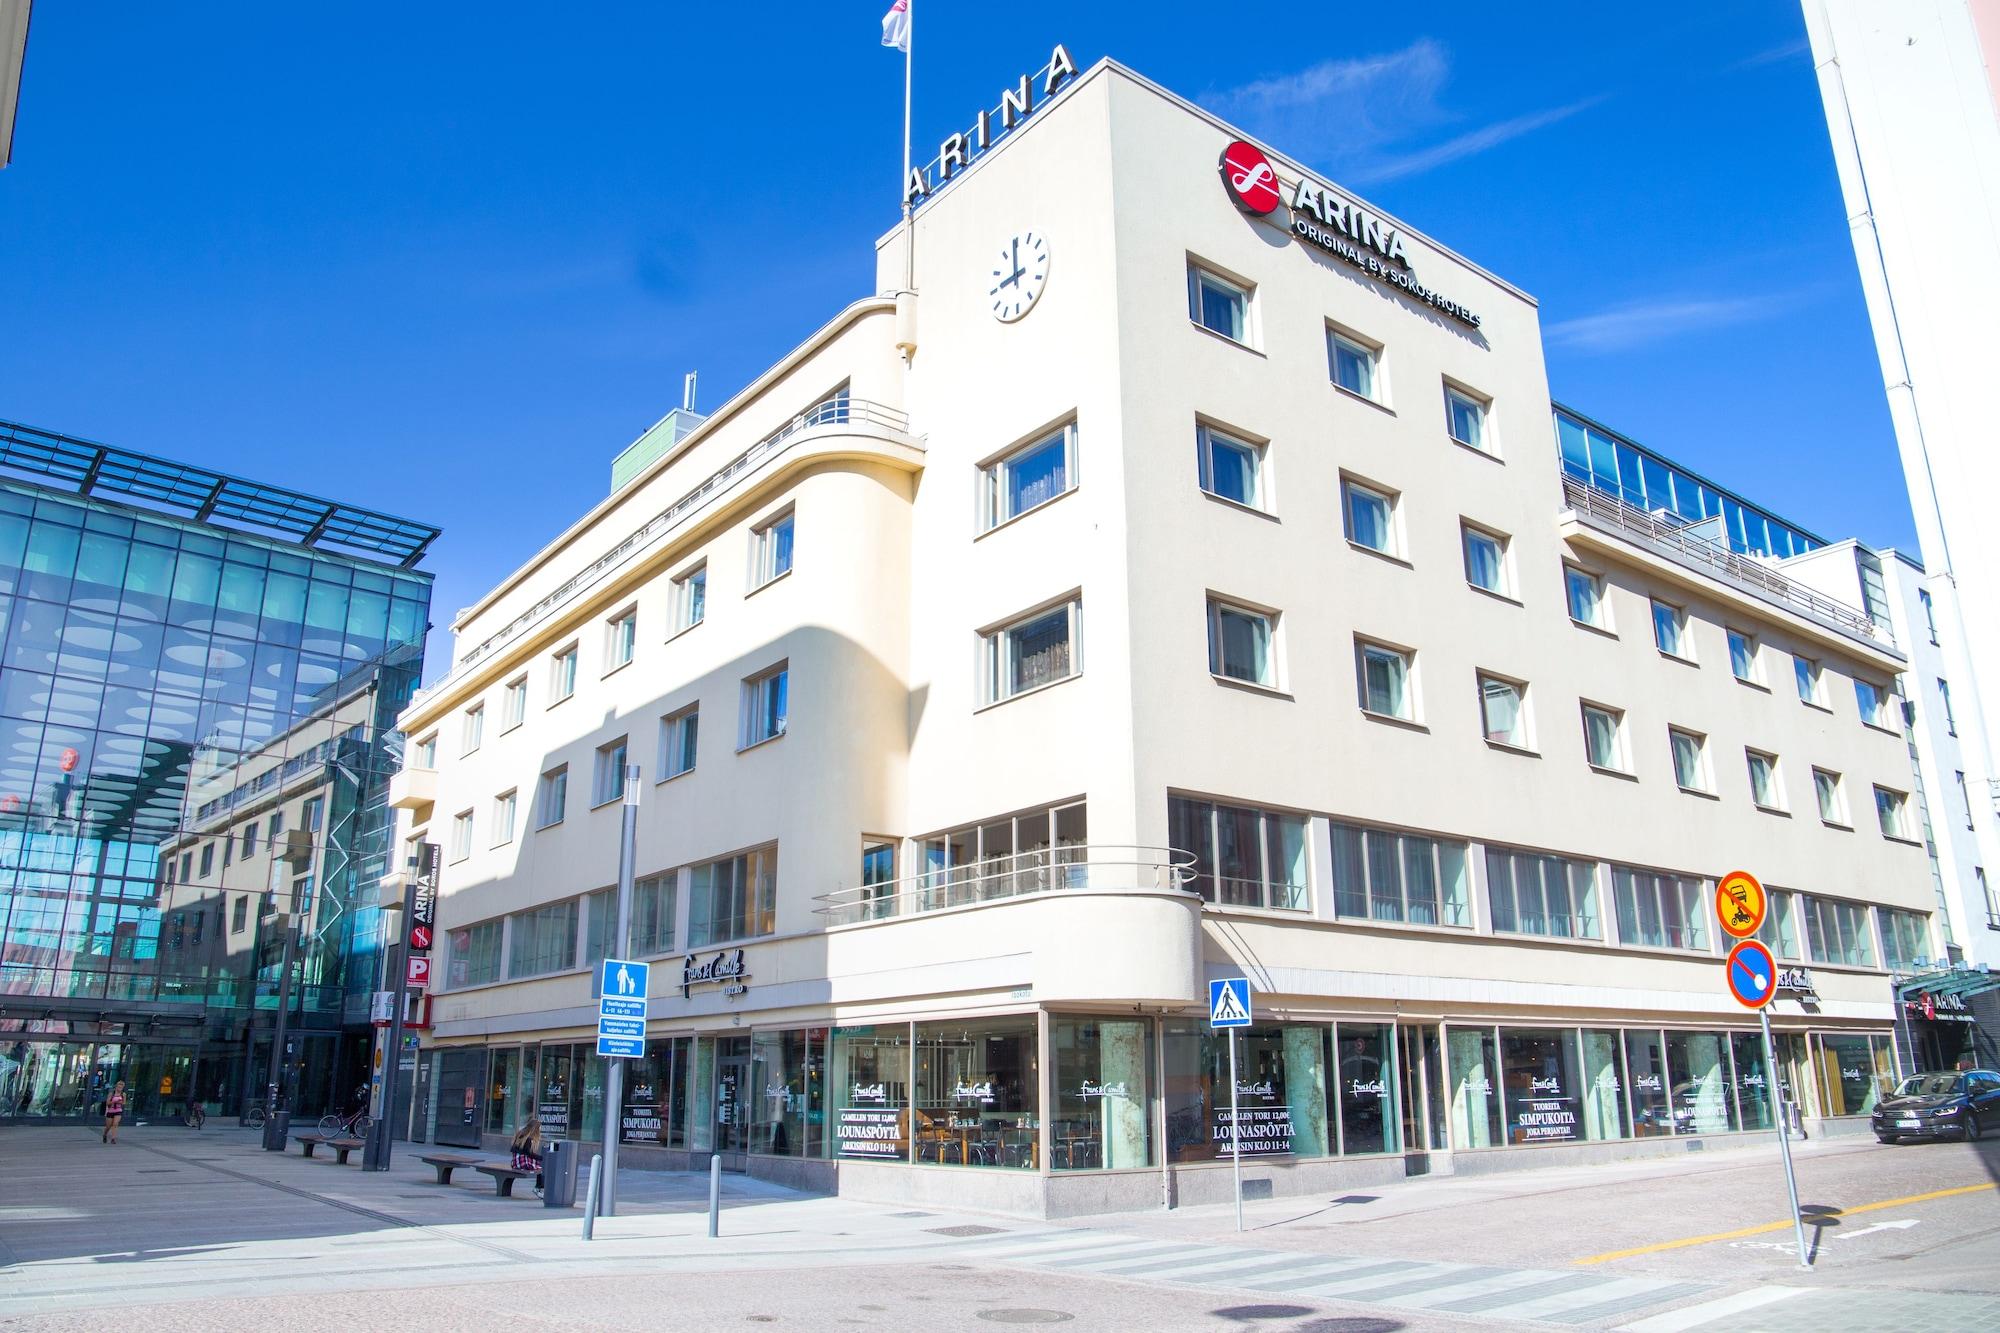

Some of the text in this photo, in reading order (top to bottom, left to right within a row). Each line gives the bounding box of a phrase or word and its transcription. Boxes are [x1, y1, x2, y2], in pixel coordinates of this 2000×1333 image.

[908, 44, 1079, 205] ARINA
[1296, 179, 1413, 269] ARINA
[1297, 220, 1481, 326] ORIGINAL BY SOKOS HOTELS
[414, 875, 430, 922] ARINA
[409, 960, 427, 978] P
[1936, 994, 1962, 1010] ARINA
[623, 1118, 660, 1129] SIMPUKOITA
[867, 1114, 880, 1122] TORI
[1218, 1112, 1252, 1121] CAMLLEN
[1254, 1112, 1271, 1120] TORI
[1520, 1112, 1575, 1125] SIMPUKOITA
[837, 1124, 901, 1139] LOUNASPÖYTÄ
[866, 1142, 879, 1151] KLO
[880, 1143, 895, 1152] 11-14
[1221, 1140, 1290, 1152] ARISIN KLO 11-14
